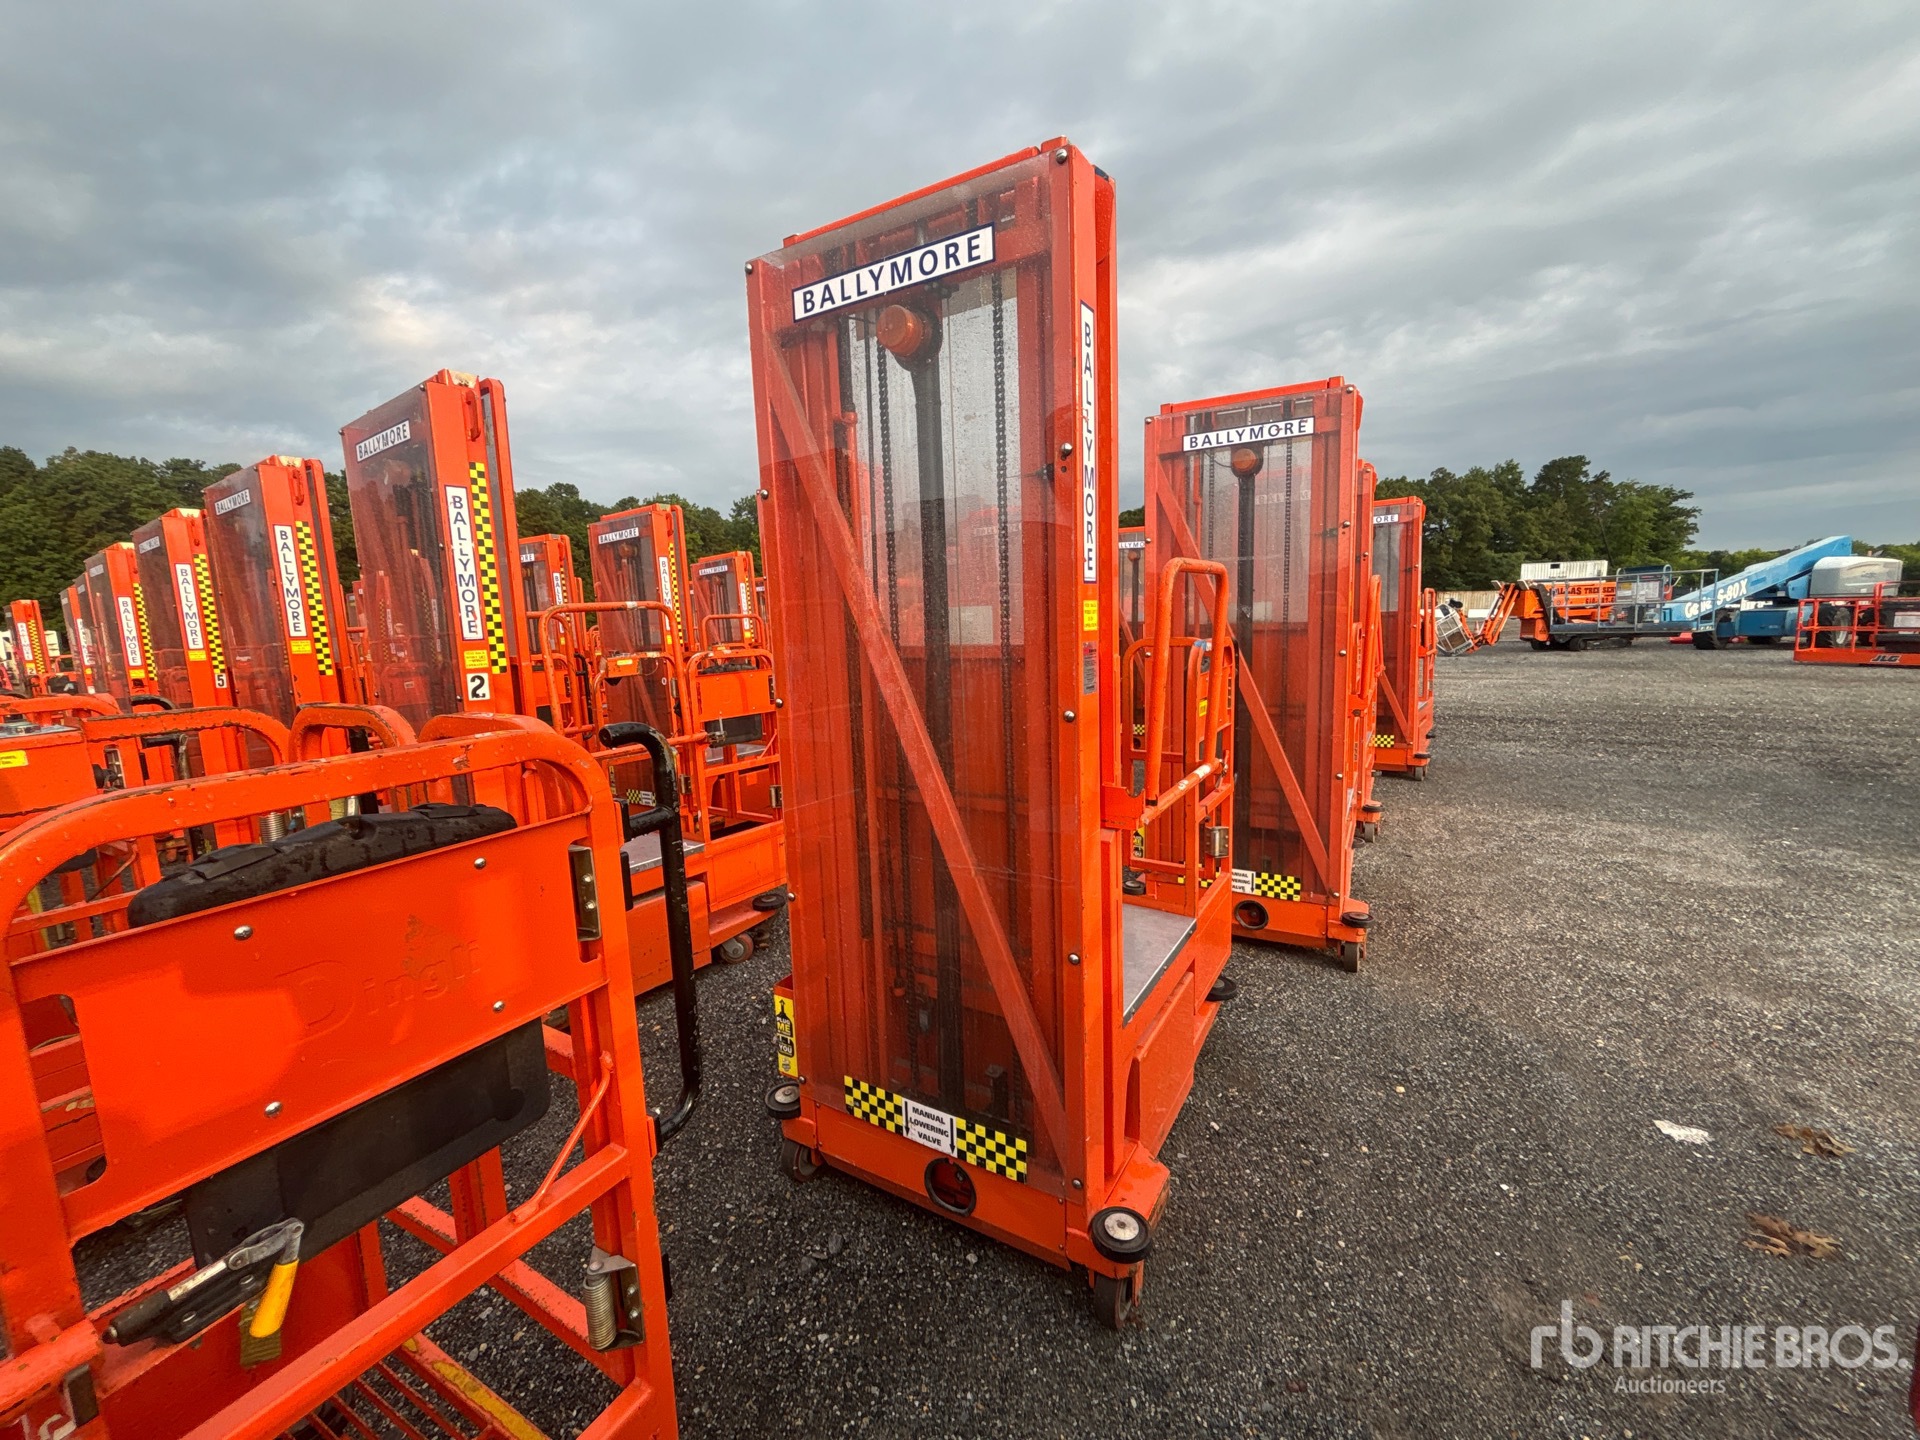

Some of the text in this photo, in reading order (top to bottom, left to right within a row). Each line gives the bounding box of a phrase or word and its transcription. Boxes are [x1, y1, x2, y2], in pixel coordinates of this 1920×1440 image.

[802, 233, 982, 315] BALLYMORE
[358, 424, 409, 459] BALLYMORE
[1190, 419, 1308, 449] BALLYMORE
[1084, 321, 1095, 572] BALLYMORE
[216, 491, 249, 514] BALLYMORE
[599, 528, 637, 543] BALLYMORE
[453, 495, 478, 634] BALLYMORE
[280, 530, 302, 632] BALLYMORE
[661, 560, 672, 605] BALLYM
[180, 569, 199, 645] BALLYMORE
[122, 600, 138, 663] BALLYMORE
[1871, 654, 1900, 662] JLG
[217, 675, 225, 687] 5
[471, 675, 486, 698] 2
[776, 1016, 791, 1025] PLUG
[777, 1022, 791, 1033] ME
[778, 1043, 793, 1054] YOU
[909, 1116, 949, 1138] LOWERING
[912, 1106, 946, 1125] MANUAL
[917, 1131, 942, 1147] VALVE
